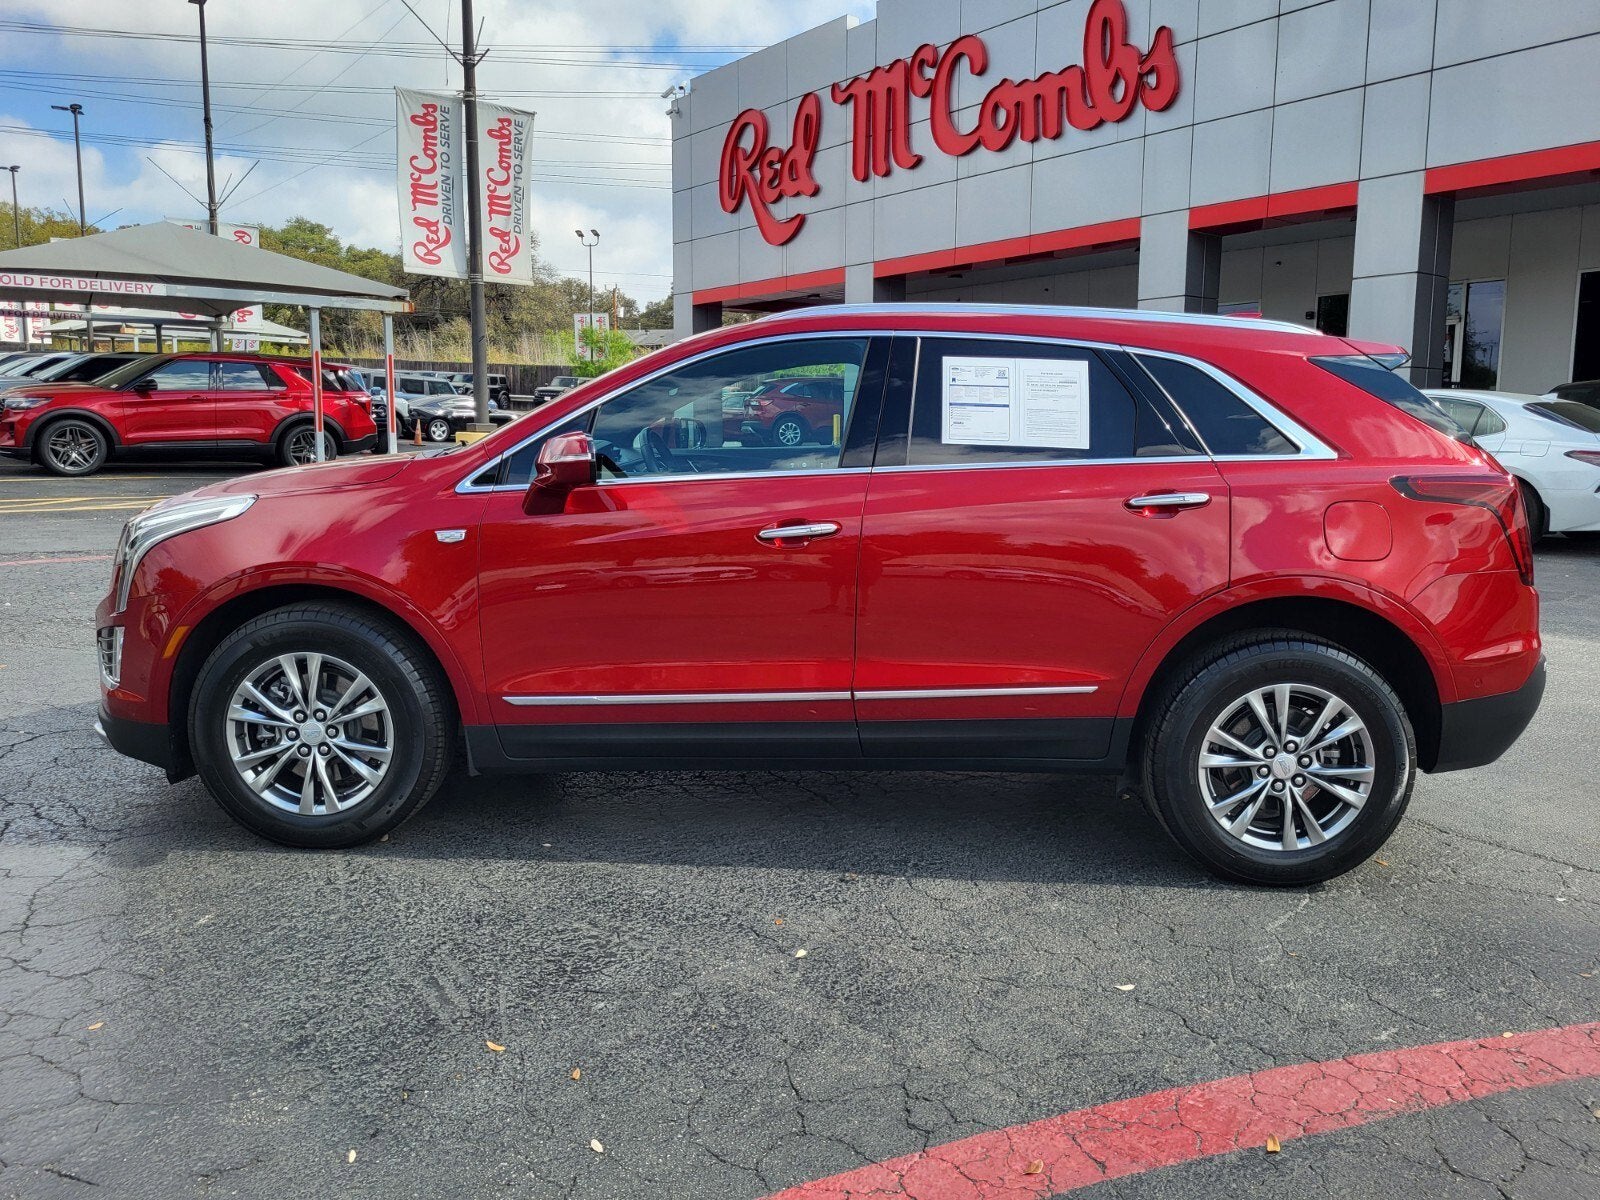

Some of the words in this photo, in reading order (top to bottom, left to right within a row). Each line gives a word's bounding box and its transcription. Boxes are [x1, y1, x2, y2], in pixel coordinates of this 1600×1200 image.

[440, 105, 451, 149] SERVE
[514, 119, 524, 161] SERVE
[719, 92, 820, 246] Red
[831, 0, 1181, 183] McCombs
[409, 103, 439, 212] McCombs
[440, 152, 451, 172] TO
[486, 117, 513, 222] McCombs
[513, 165, 524, 183] TO
[440, 175, 453, 226] DRIVEN
[513, 185, 525, 235] DRIVEN
[413, 216, 452, 266] Red
[489, 226, 521, 275] Red
[0, 274, 34, 287] OLD
[39, 277, 73, 289] FOR
[77, 280, 154, 294] DELIVERY
[8, 310, 30, 318] FOR
[32, 311, 84, 320] DELIVERY
